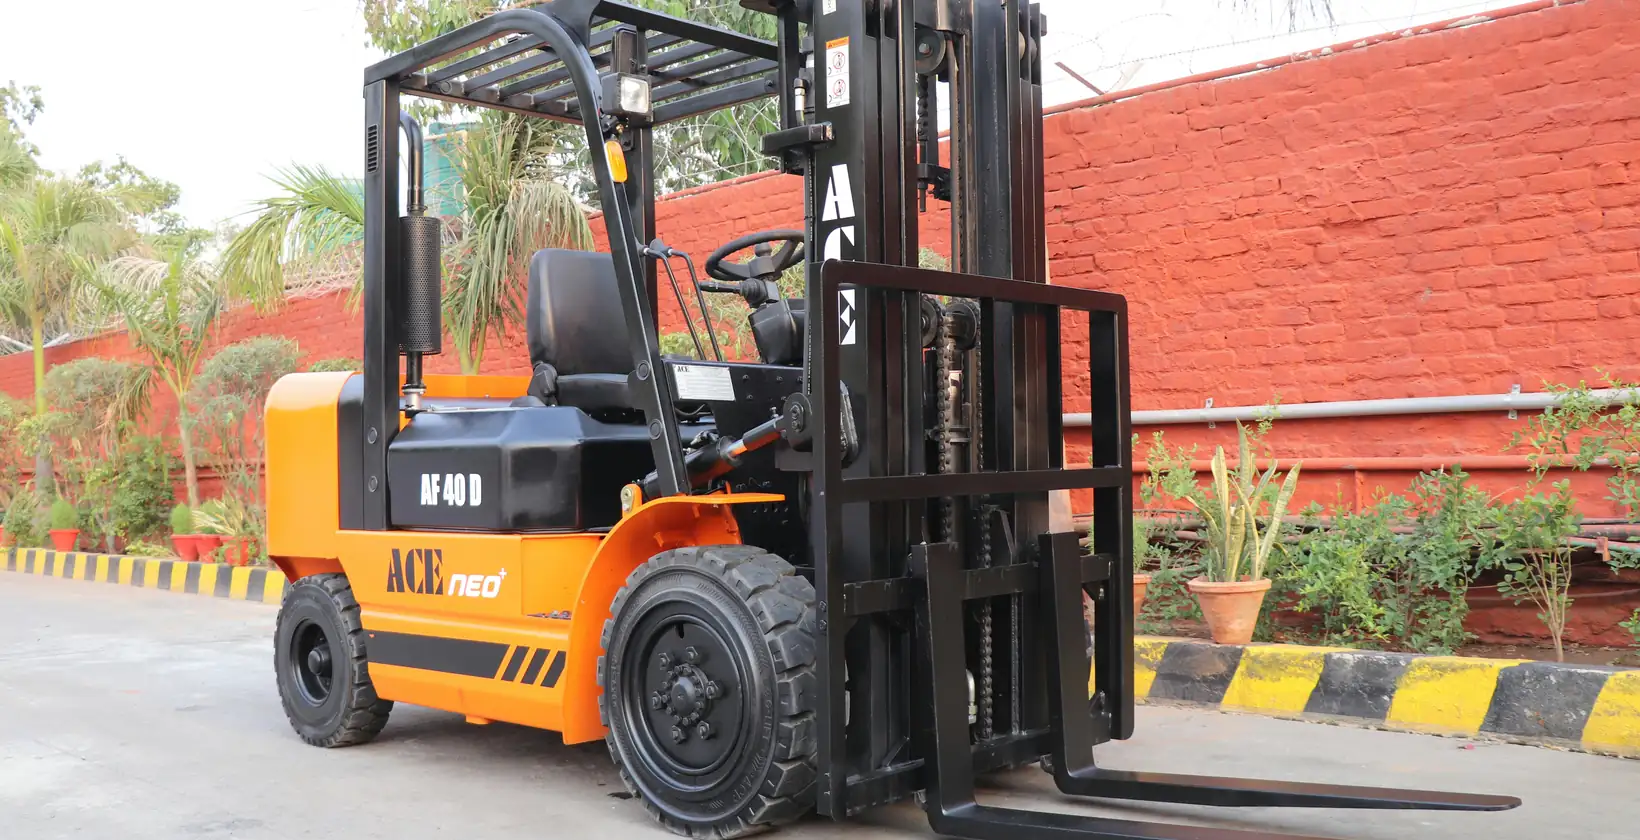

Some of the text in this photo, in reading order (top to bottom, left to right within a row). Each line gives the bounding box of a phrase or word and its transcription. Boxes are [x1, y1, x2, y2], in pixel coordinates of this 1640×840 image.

[421, 472, 482, 507] AF 40 D
[387, 548, 444, 595] ACE
